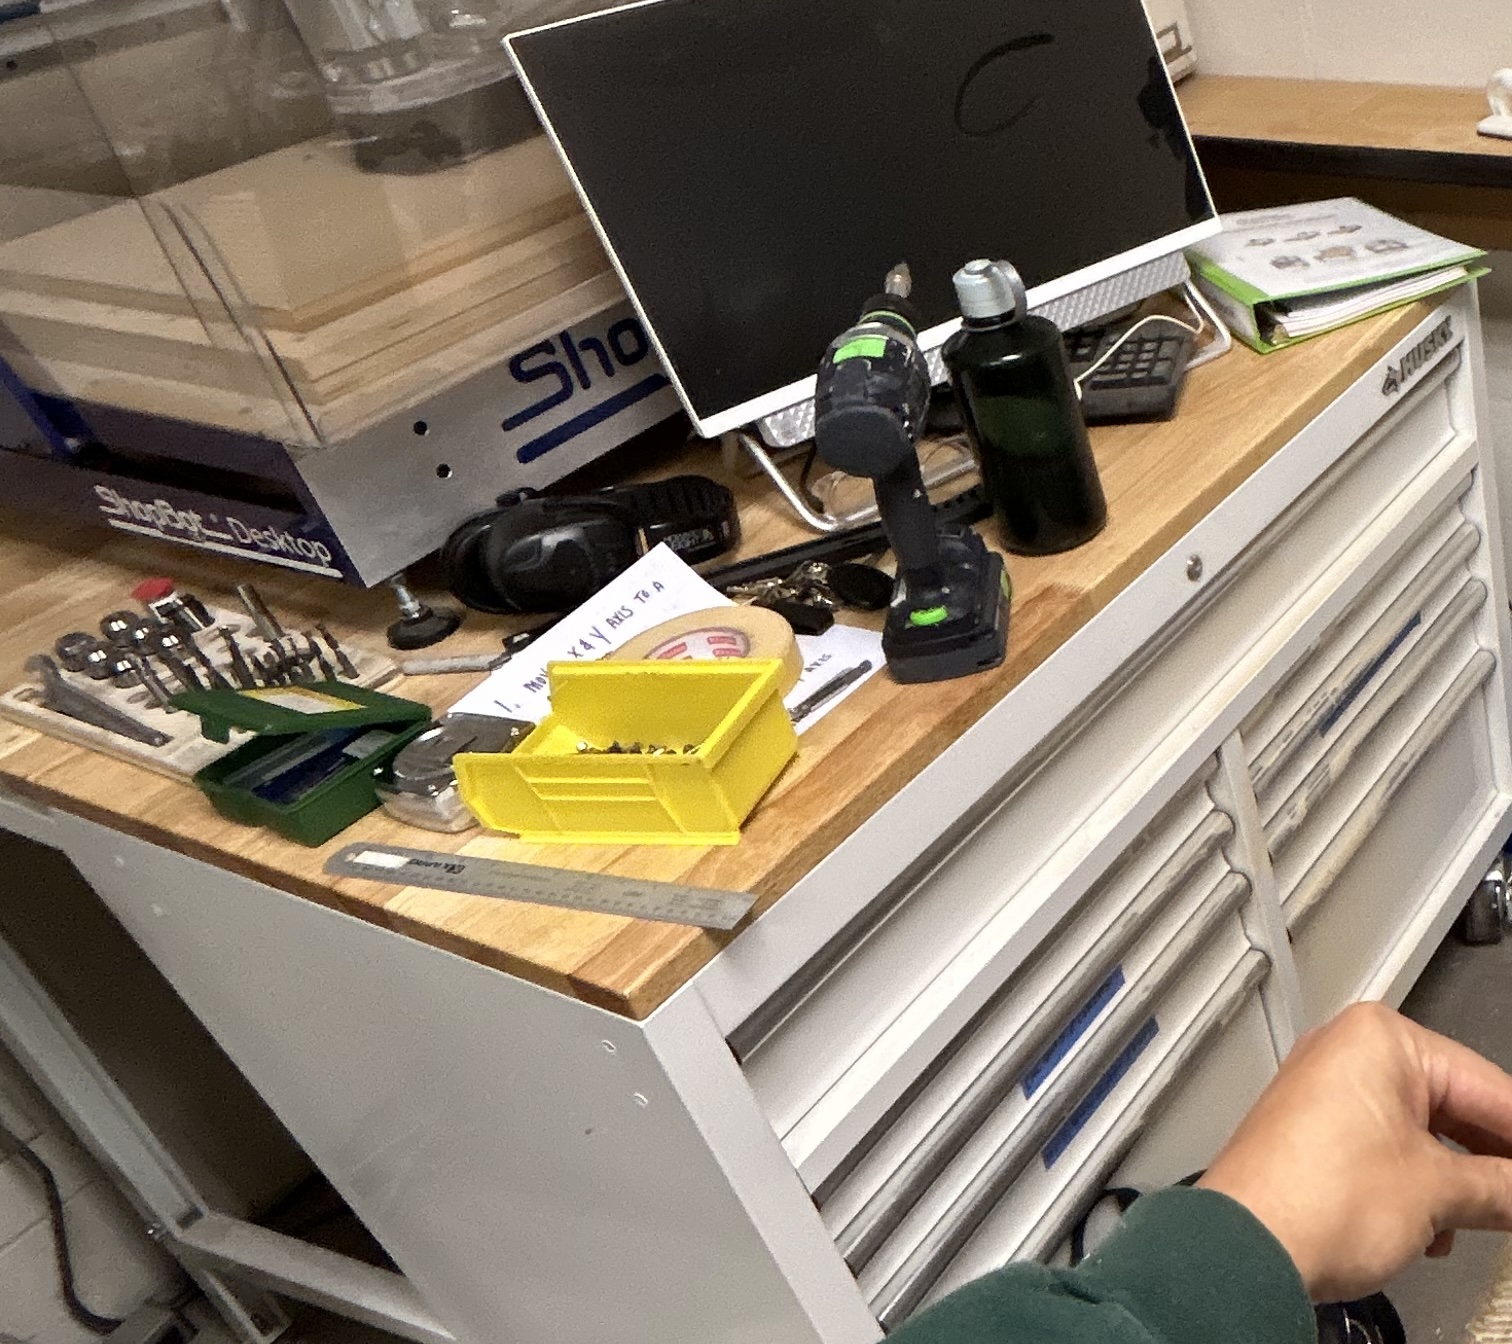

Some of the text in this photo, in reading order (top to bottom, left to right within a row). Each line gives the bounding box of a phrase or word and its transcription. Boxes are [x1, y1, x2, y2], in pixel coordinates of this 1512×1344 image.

[502, 317, 649, 432] Sho
[1400, 315, 1453, 383] HUSKY
[93, 484, 332, 568] ShopBot Desktop
[605, 605, 634, 630] AXIS
